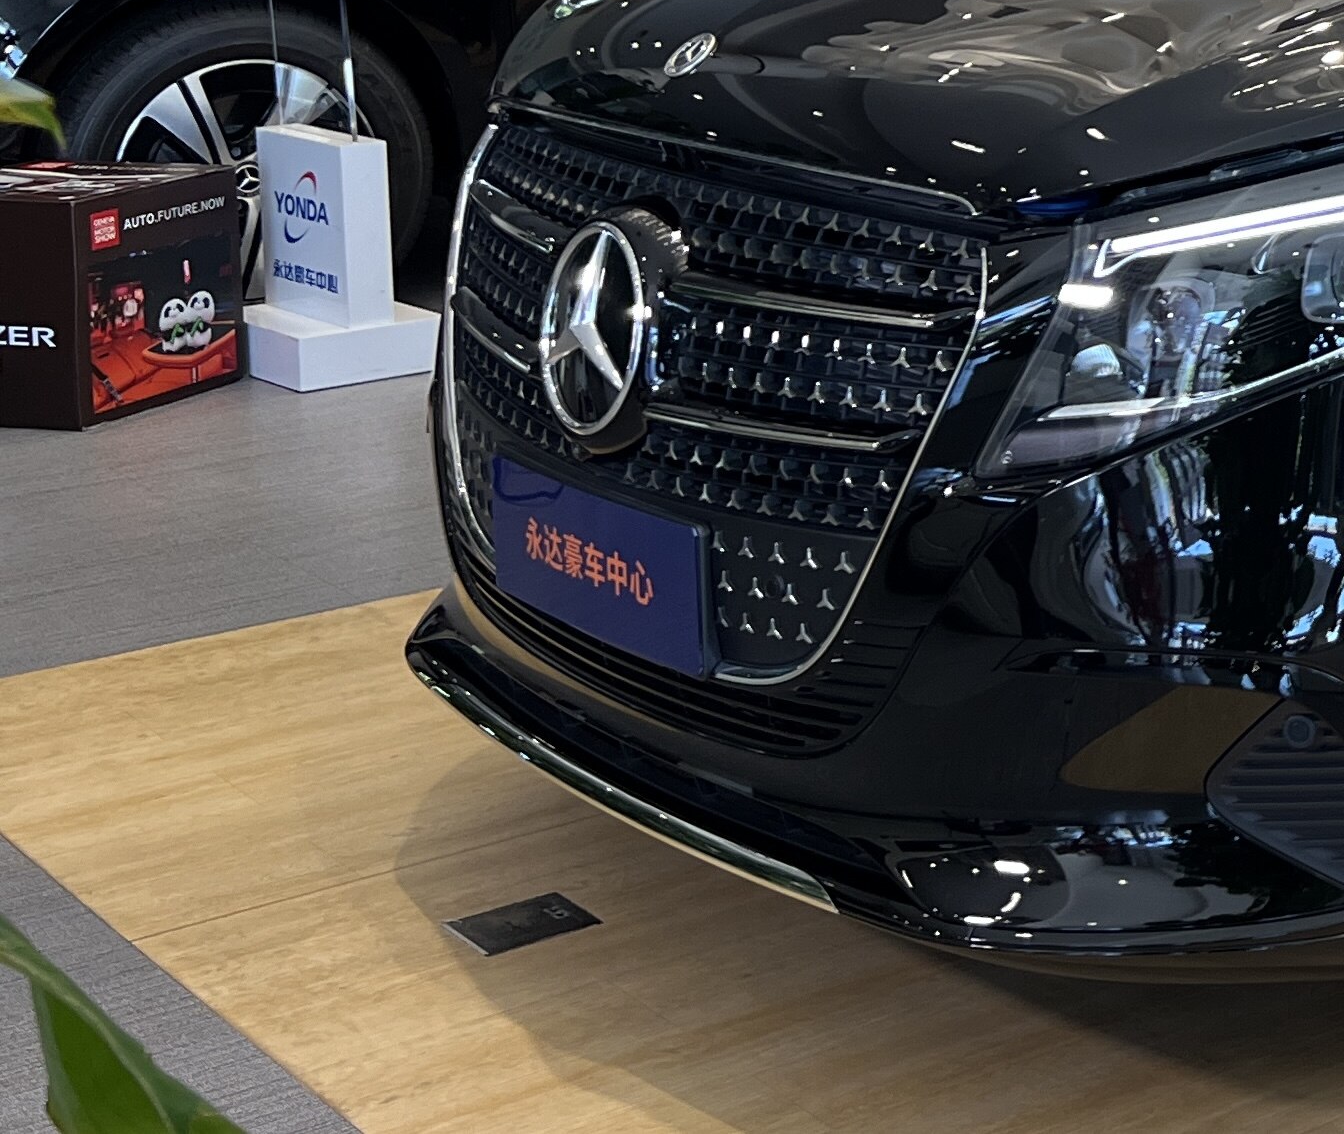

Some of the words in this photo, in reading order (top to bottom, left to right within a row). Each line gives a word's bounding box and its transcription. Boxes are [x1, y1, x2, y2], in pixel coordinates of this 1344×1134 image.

[123, 195, 226, 231] AUTO.FUTURE.NOW
[273, 190, 329, 226] YONDA
[526, 516, 655, 606] 永达豪车中心
